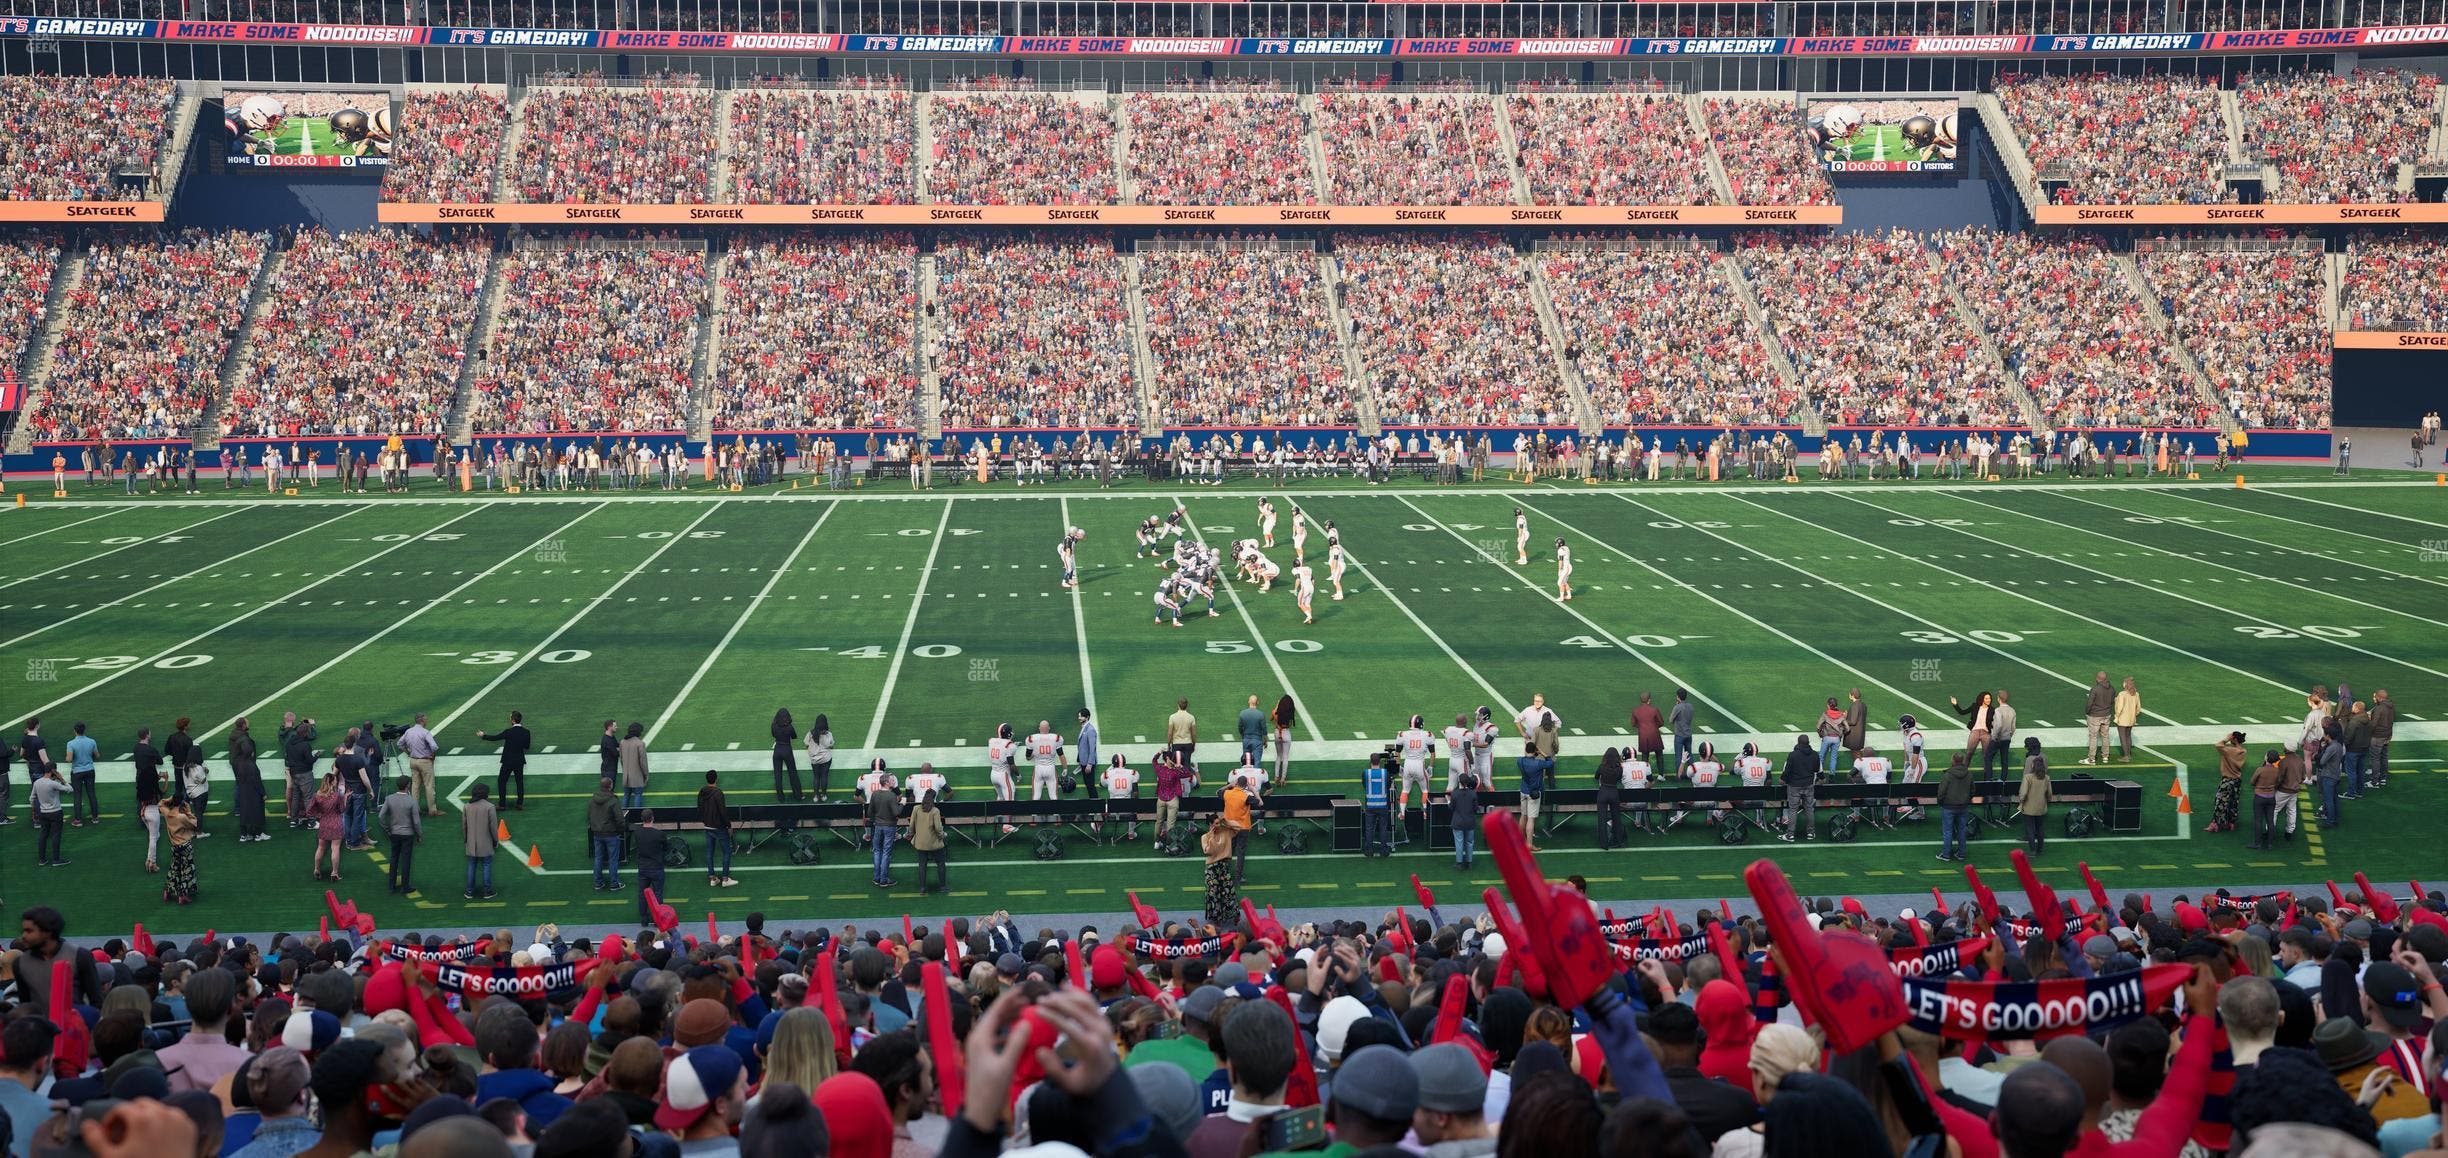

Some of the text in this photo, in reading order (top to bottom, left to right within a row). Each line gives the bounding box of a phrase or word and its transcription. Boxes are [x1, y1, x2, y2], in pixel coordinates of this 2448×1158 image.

[0, 18, 145, 37] T'S GAMEDAY!
[177, 24, 414, 42] MAKE SOME NOOOOISE!!!
[450, 29, 588, 46] IT'S GAMEDAY!
[616, 33, 831, 50] MAKE SOME NOOOOISE!!!
[2051, 35, 2192, 50] IT'S GAMEDAY!
[2223, 27, 2448, 47] MAKE SOME NOOOO
[864, 36, 898, 50] IT'S
[902, 37, 993, 51] GAMEDAY!
[1020, 39, 1224, 53] MAKE SOME NOOOOISE!!!
[1257, 40, 1384, 54] IT'S GAMEDAY!
[1409, 40, 1615, 54] MAKE SOME NOOOOISE!!!
[1646, 40, 1777, 54] IT'S GAMEDAY!
[1801, 37, 2018, 52] MAKE SOME NOOOOISE!!!
[228, 156, 251, 164] HOME
[274, 155, 318, 165] 00:00
[359, 157, 388, 165] VISITOR
[1924, 162, 1954, 170] VISITORS
[1848, 162, 1887, 171] 00:00
[67, 205, 137, 217] SEATGEEK
[439, 208, 496, 219] SEATGEEK
[566, 208, 622, 219] SEATGEEK
[690, 209, 744, 220] SEATGEEK
[811, 209, 865, 220] SEATGEEK
[930, 209, 983, 220] SEATGEEK
[1048, 209, 1100, 220] SEATGEEK
[1165, 209, 1215, 220] SEATGEEK
[1280, 210, 1331, 220] SEATGEEK
[1395, 210, 1446, 220] SEATGEEK
[1511, 210, 1562, 220] SEATGEEK
[1627, 210, 1679, 220] SEATGEEK
[1745, 210, 1797, 220] SEATGEEK
[2078, 208, 2135, 220] SEATGEEK
[2207, 208, 2265, 219] SEATGEEK
[2339, 208, 2401, 219] SEATGEEK
[2399, 335, 2448, 346] SEATGE
[1900, 630, 2024, 644] 30
[2233, 625, 2362, 639] 20
[1204, 640, 1324, 654] 50
[1559, 635, 1678, 648] 40
[460, 649, 592, 664] 30
[837, 644, 962, 659] 40
[67, 655, 214, 670] 20
[1039, 745, 1051, 755] 00
[1409, 739, 1422, 749] 00
[1751, 766, 1763, 777] 00
[1870, 762, 1882, 772] 00
[1632, 770, 1643, 780] 00
[1700, 773, 1713, 783] 00
[920, 778, 932, 788] 00
[1114, 778, 1127, 790] 00
[1601, 918, 1643, 935] OOOOO!!!
[391, 943, 475, 962] LET'S GOOOOO!!!
[1136, 937, 1221, 957] LET'S GOOOOO!!!
[1608, 937, 1707, 961] T'S GOOOOO!!!
[438, 964, 576, 994] LET'S GOOOOO!!!
[1903, 977, 2142, 1032] LET'S GOOOOO!!!
